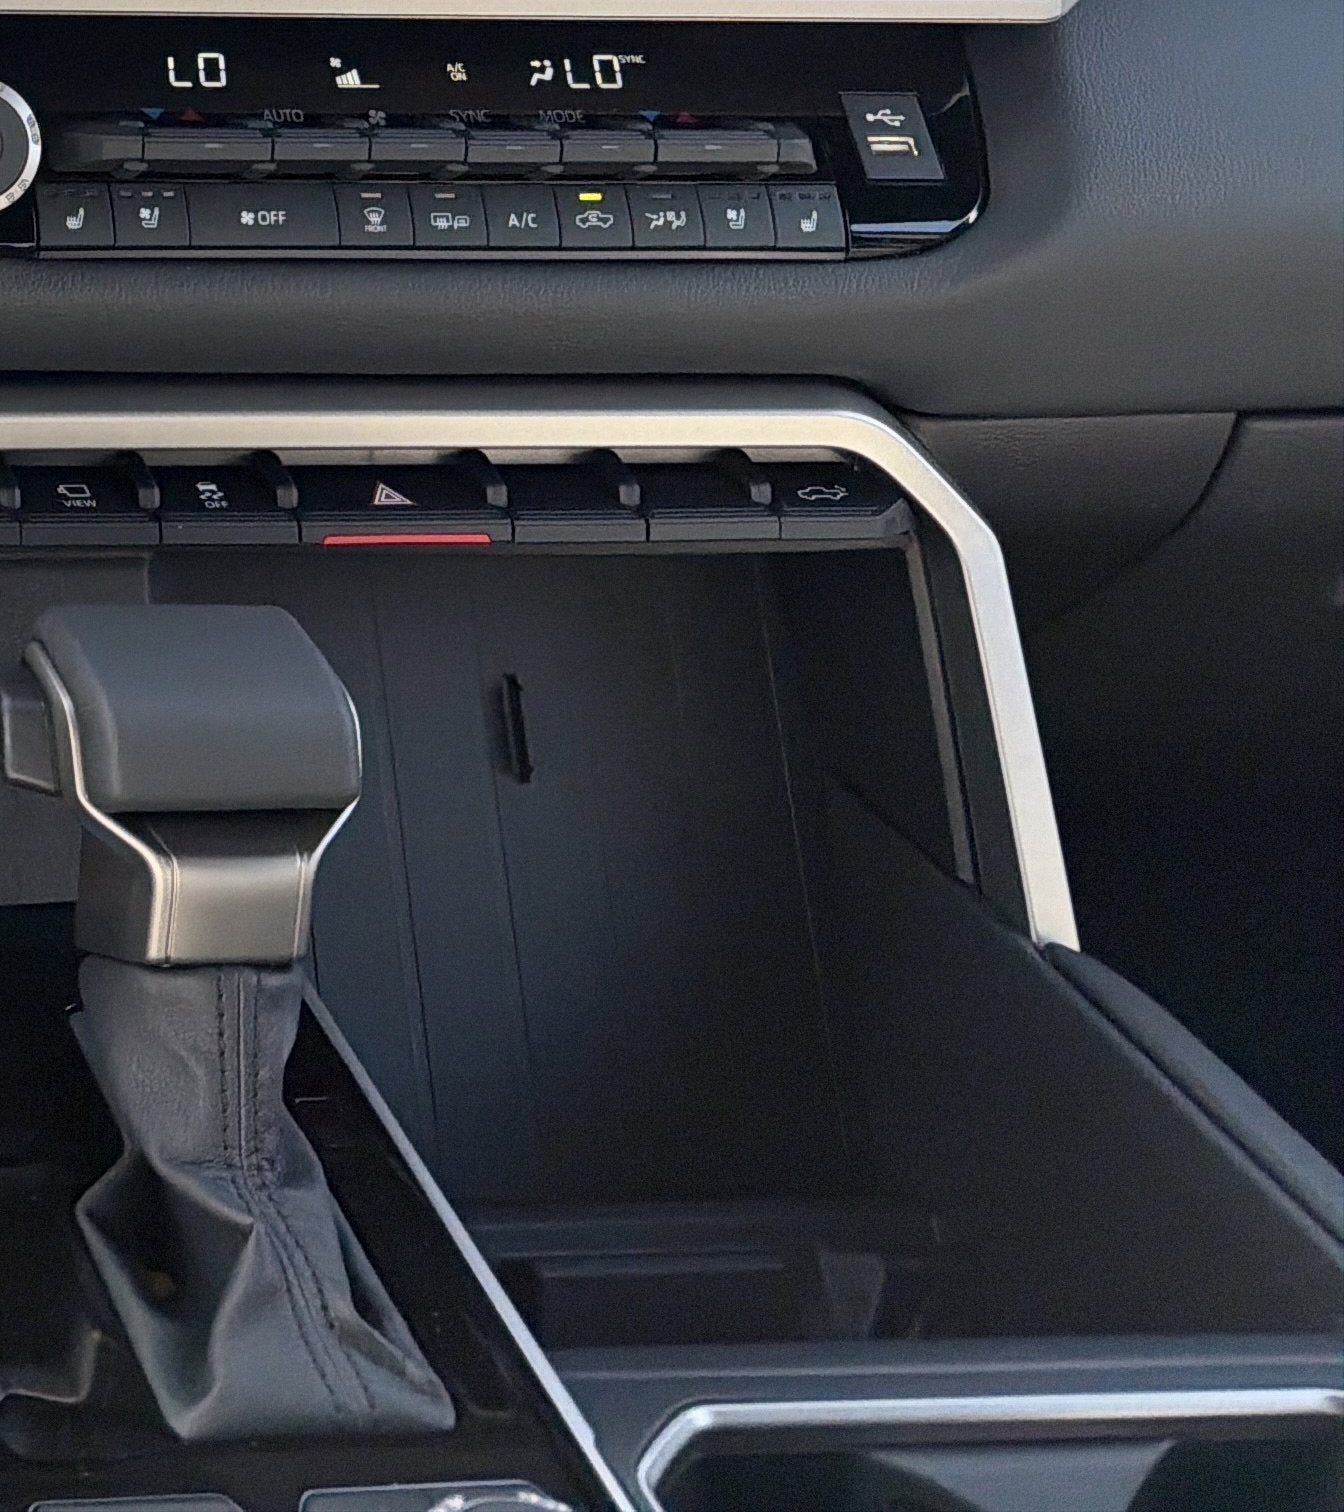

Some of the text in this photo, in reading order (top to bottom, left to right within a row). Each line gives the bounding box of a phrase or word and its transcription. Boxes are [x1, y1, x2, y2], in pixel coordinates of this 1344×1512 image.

[167, 52, 227, 88] LO
[446, 61, 466, 74] A/C
[263, 109, 304, 123] AUTO
[448, 109, 492, 124] SYNC
[538, 110, 586, 124] MODE
[257, 211, 287, 226] OFF
[508, 213, 538, 228] A/C
[364, 224, 387, 232] FRONT
[62, 499, 97, 508] VIEW
[205, 500, 229, 510] OFF
